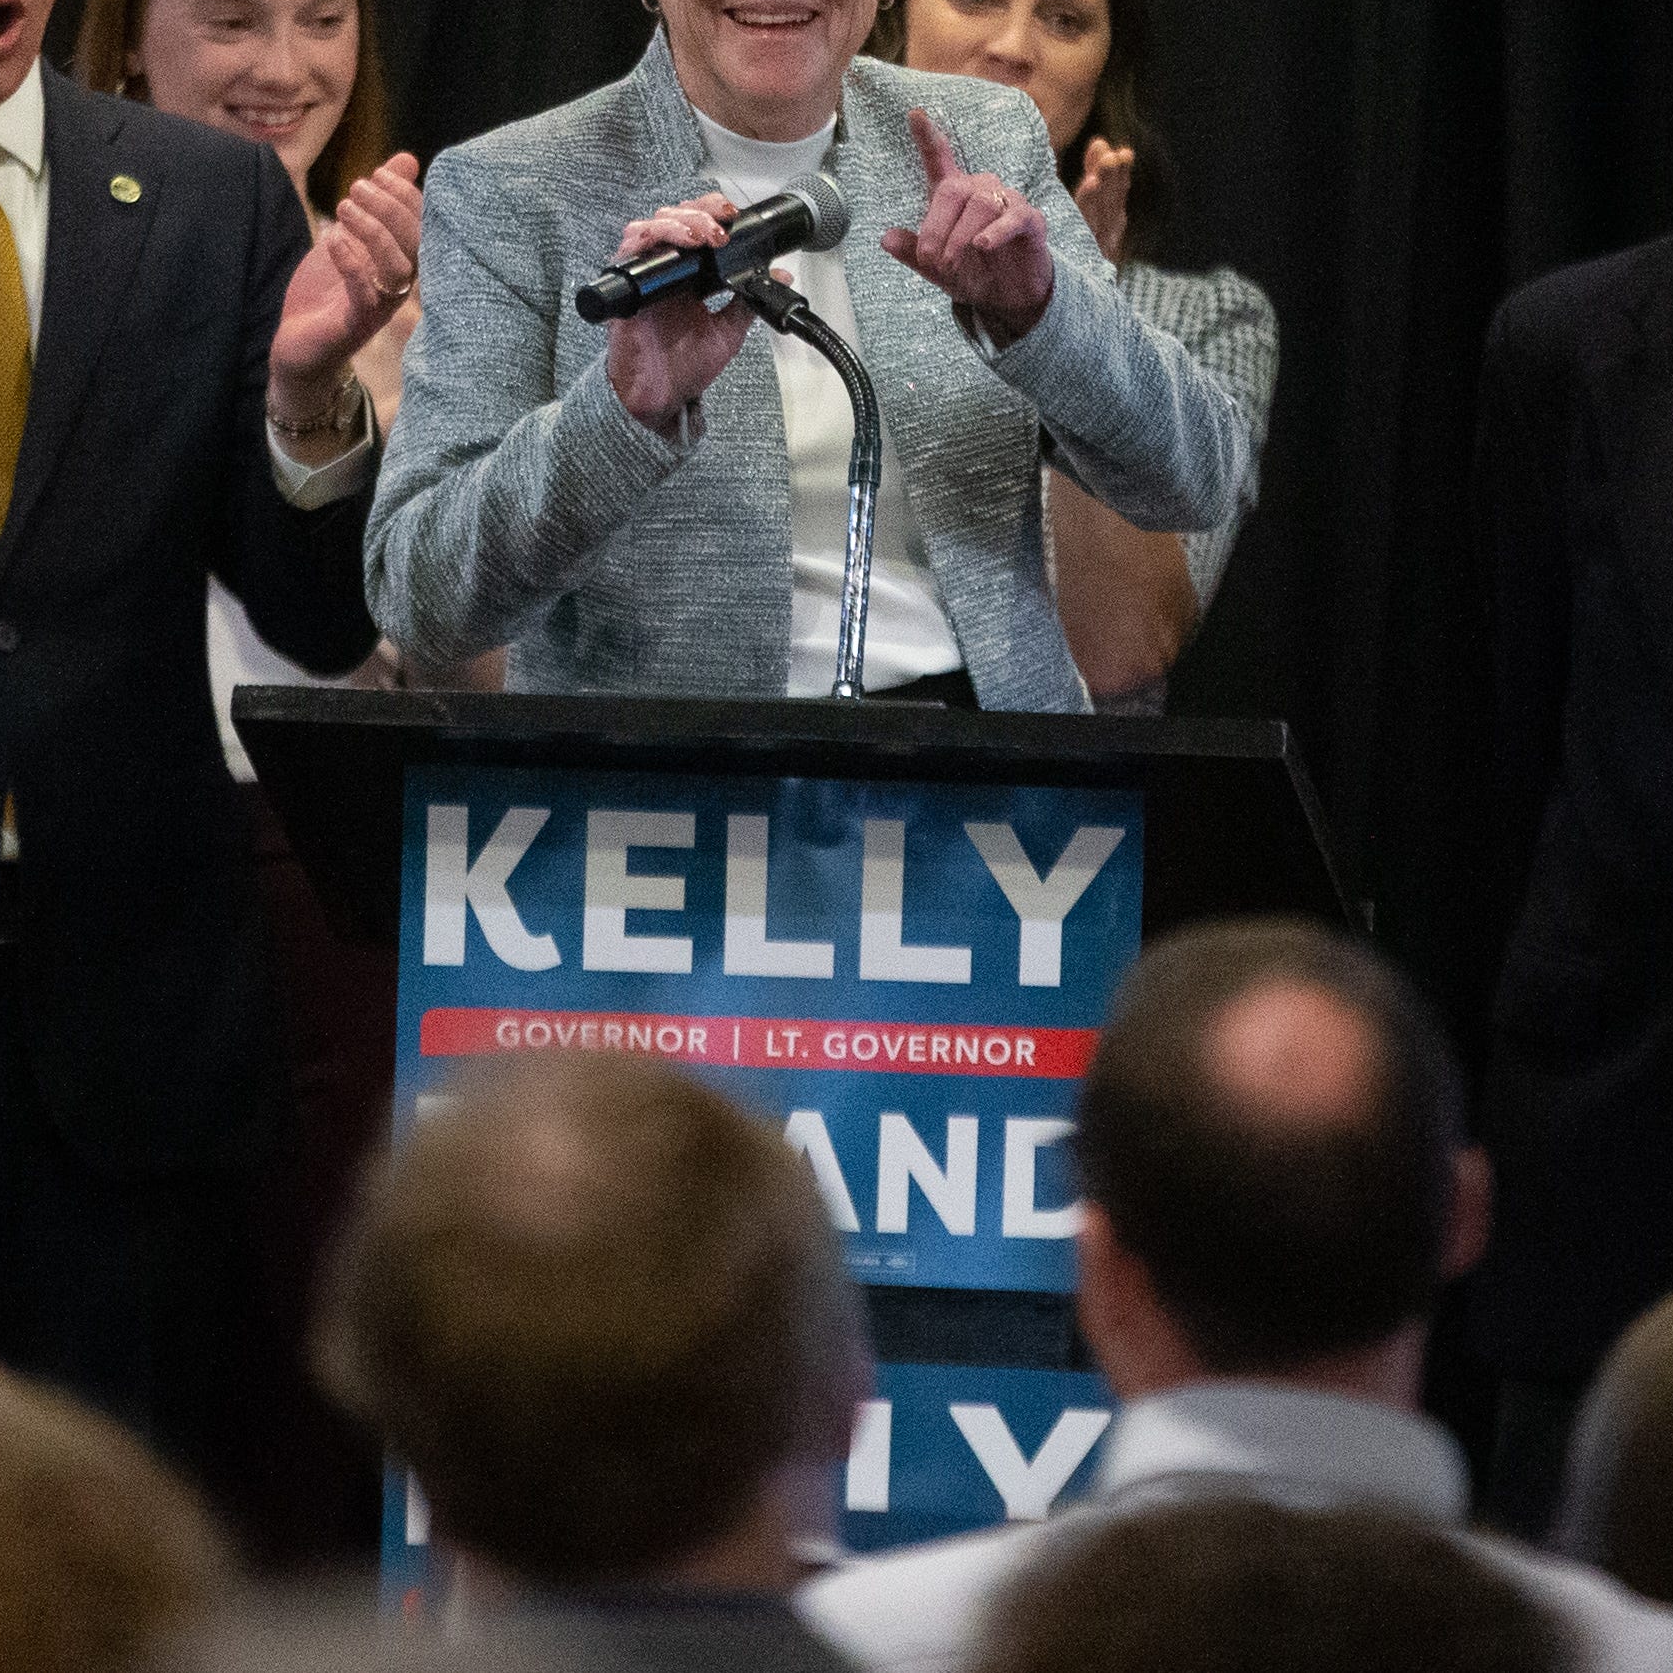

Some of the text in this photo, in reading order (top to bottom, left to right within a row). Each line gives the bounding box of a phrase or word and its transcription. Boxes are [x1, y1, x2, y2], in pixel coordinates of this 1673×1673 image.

[421, 803, 1127, 989] KELLY
[495, 1018, 1038, 1069] GOVERNOR LT. GOVERNOR
